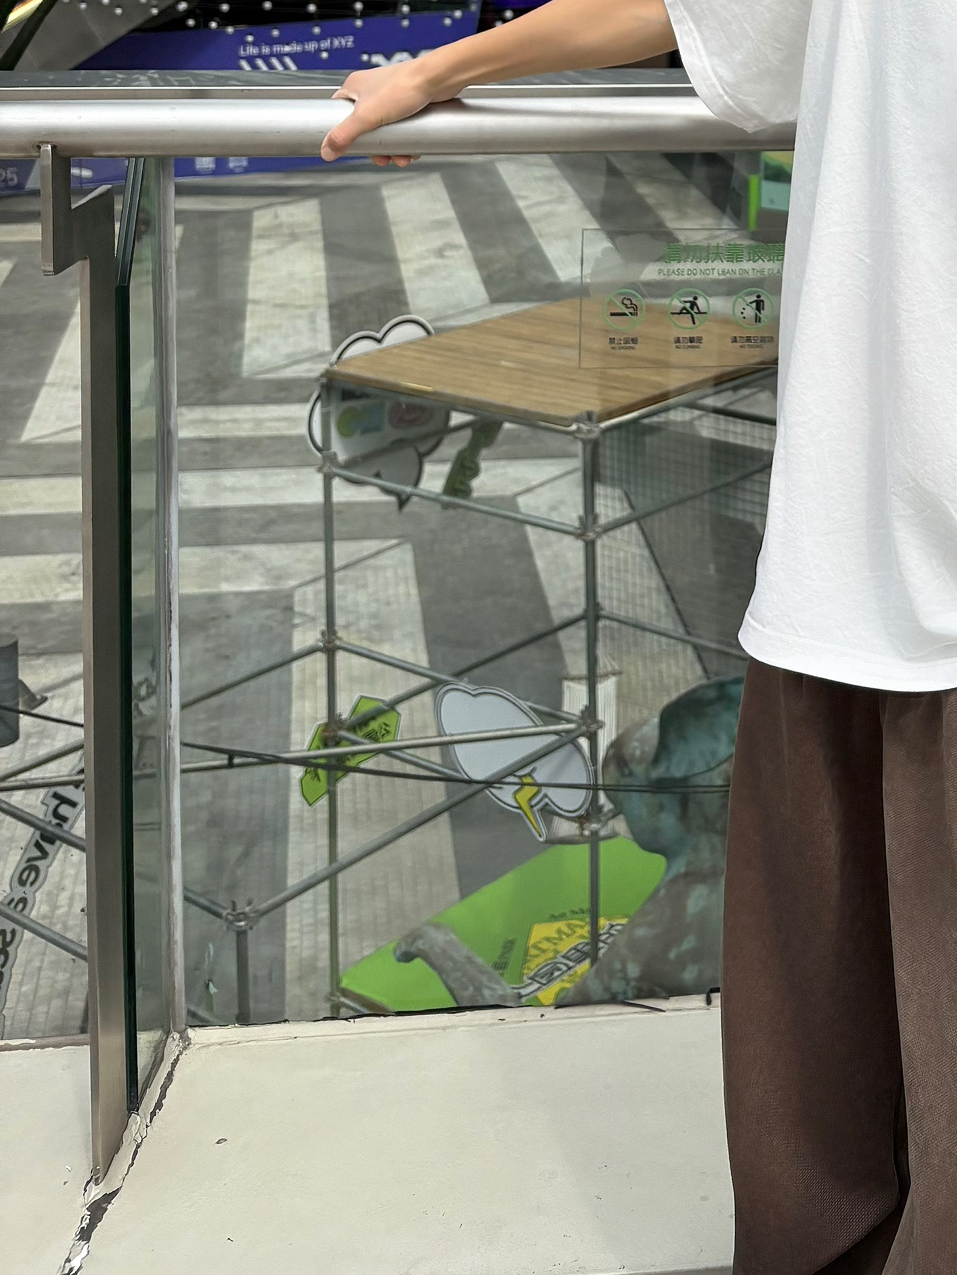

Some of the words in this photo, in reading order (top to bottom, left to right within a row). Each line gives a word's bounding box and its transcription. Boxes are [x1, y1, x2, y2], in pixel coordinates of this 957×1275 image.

[239, 45, 259, 56] Life
[262, 43, 271, 55] is
[273, 41, 302, 54] made
[304, 41, 318, 53] up
[320, 37, 331, 49] of
[332, 36, 354, 49] XYZ
[658, 268, 685, 276] PLEASE
[687, 268, 698, 276] DO
[700, 268, 716, 276] NOT
[717, 268, 736, 276] LEAN
[751, 268, 765, 276] THE
